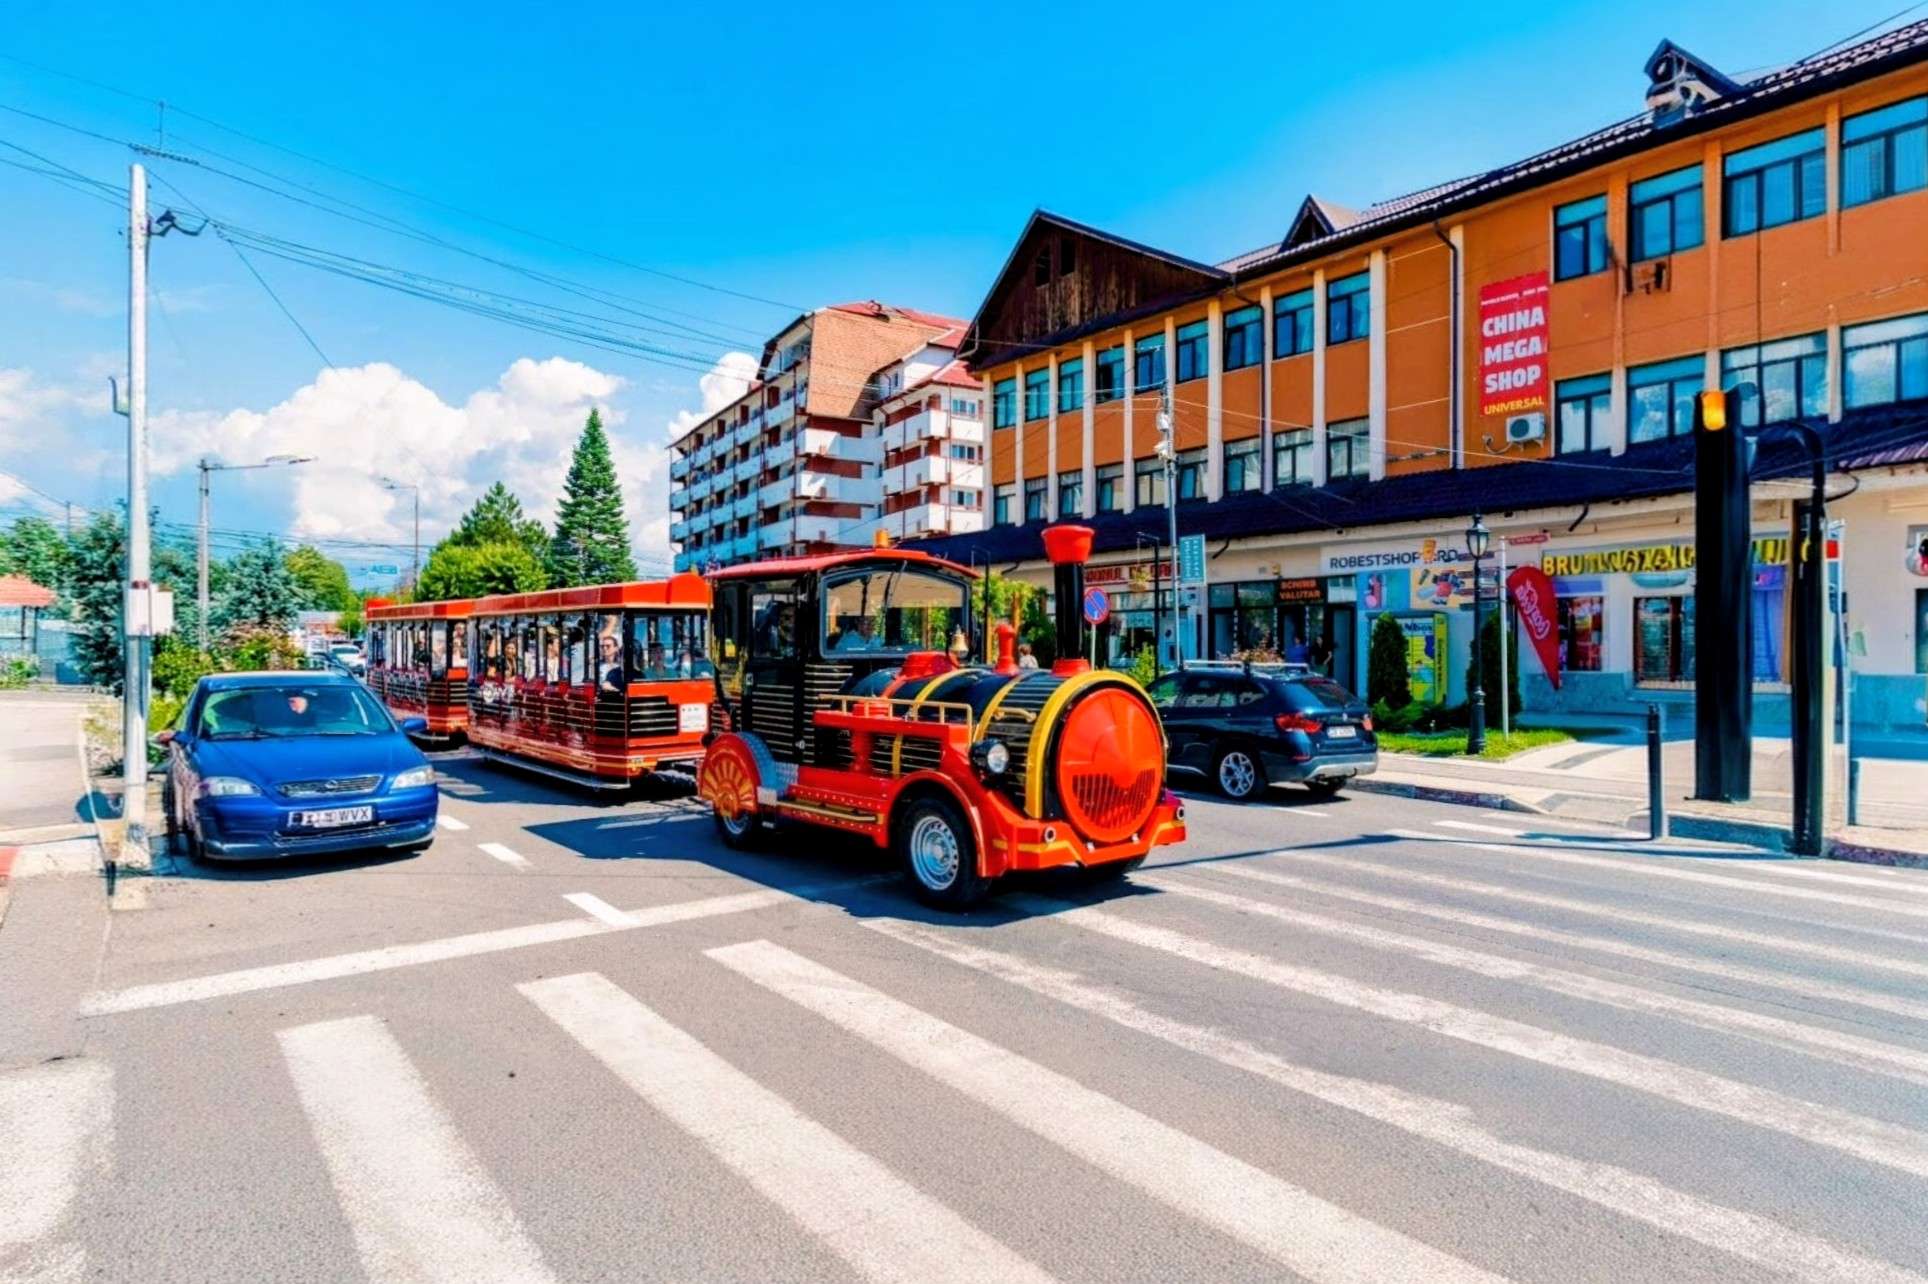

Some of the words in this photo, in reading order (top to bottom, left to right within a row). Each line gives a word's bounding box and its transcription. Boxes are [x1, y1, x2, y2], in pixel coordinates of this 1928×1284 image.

[1482, 306, 1545, 338] CHINA
[1484, 336, 1542, 366] MEGA
[1485, 365, 1541, 394] SHOP
[1484, 396, 1544, 415] UNIVERSAL
